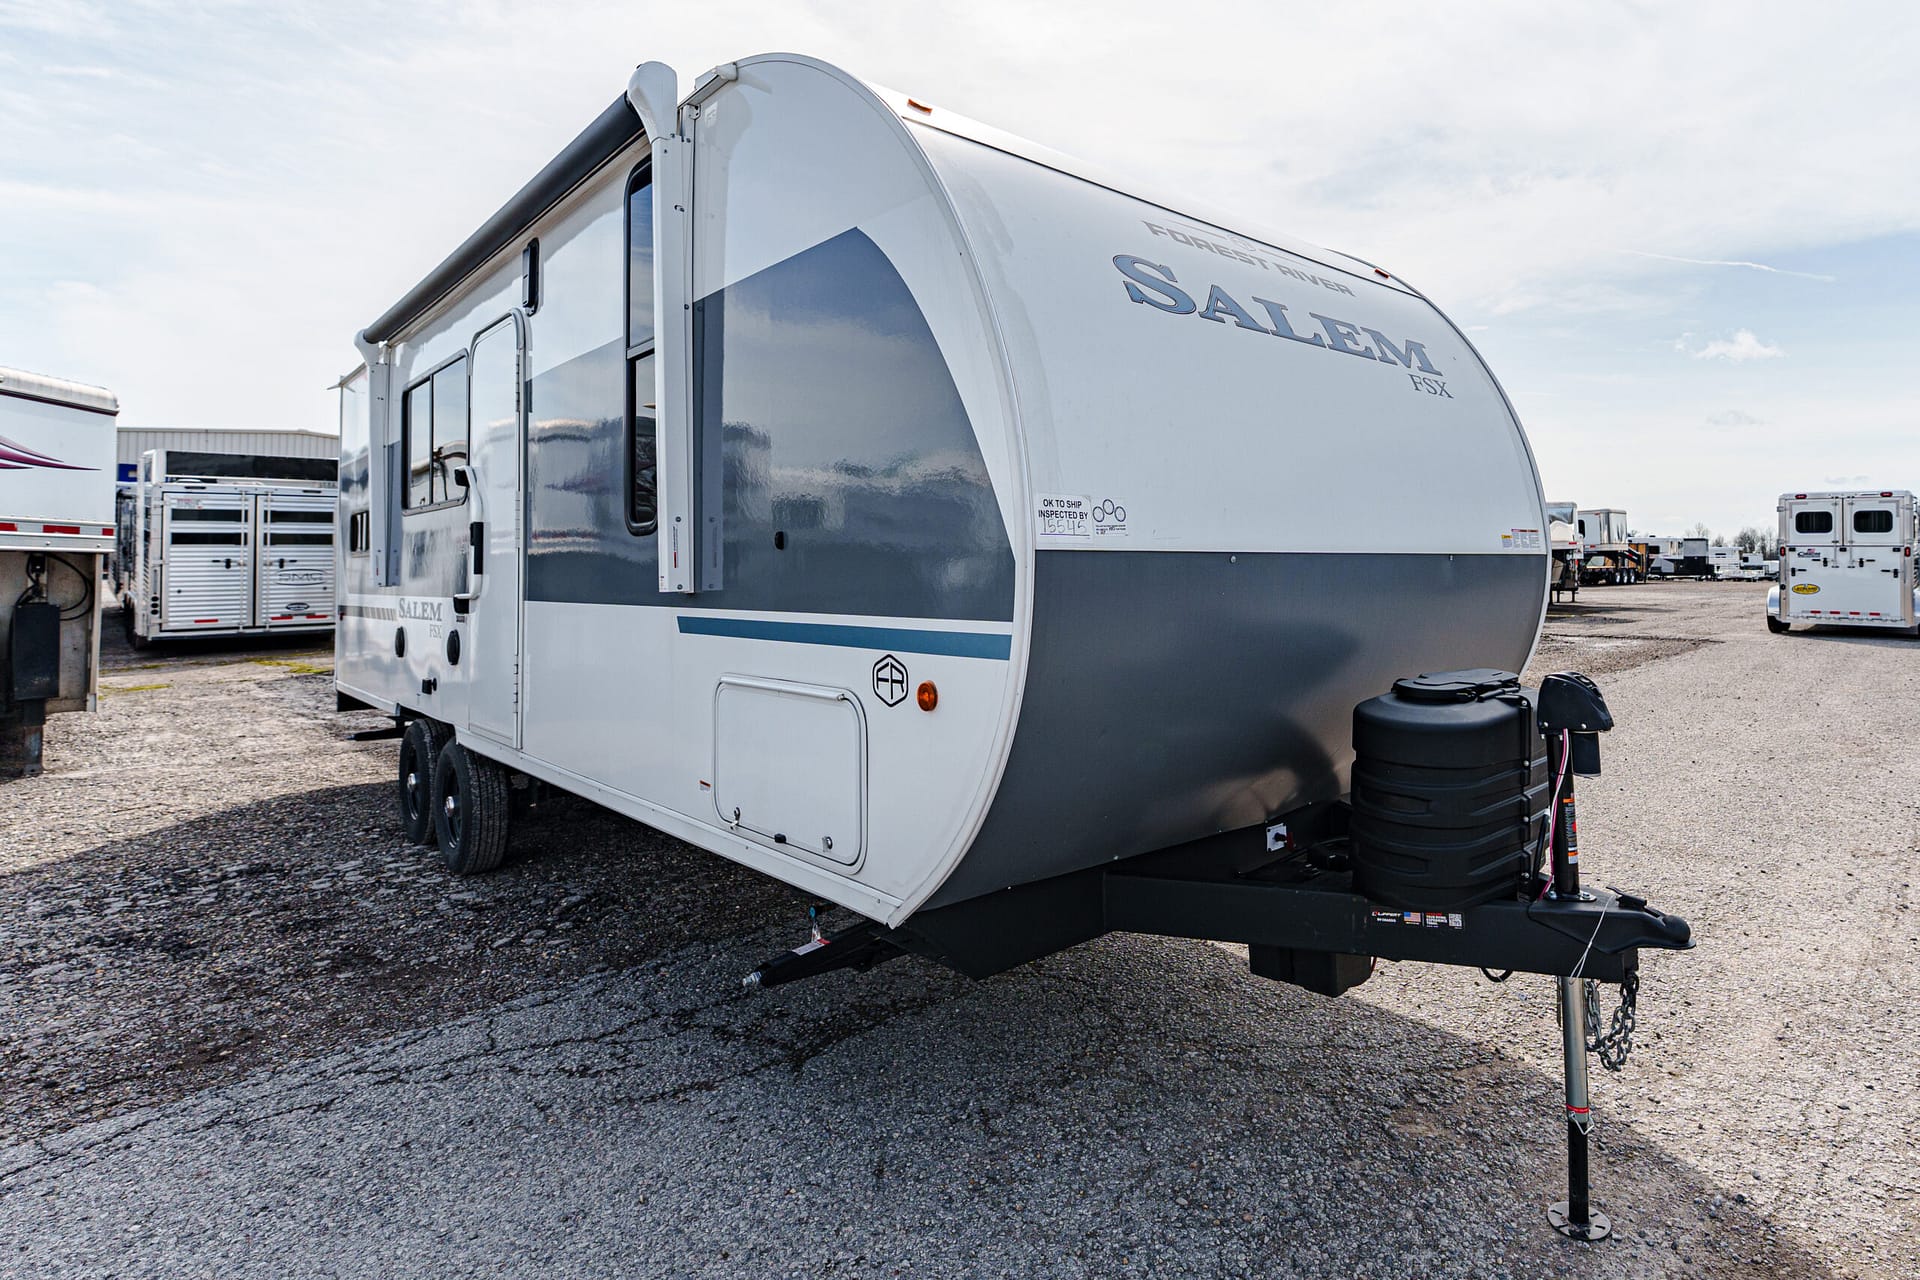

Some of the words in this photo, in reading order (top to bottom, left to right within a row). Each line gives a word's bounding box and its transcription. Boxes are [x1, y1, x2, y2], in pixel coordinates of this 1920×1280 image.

[1143, 220, 1269, 270] FOREST
[1273, 262, 1356, 297] RIVER
[1113, 254, 1443, 377] SALEM
[1408, 373, 1454, 399] FSX
[1038, 509, 1078, 520] INSPECTED
[1079, 511, 1089, 520] BY
[1043, 498, 1055, 508] OK
[1055, 499, 1065, 508] TO
[1066, 500, 1082, 509] SHIP
[399, 597, 442, 621] SALEM
